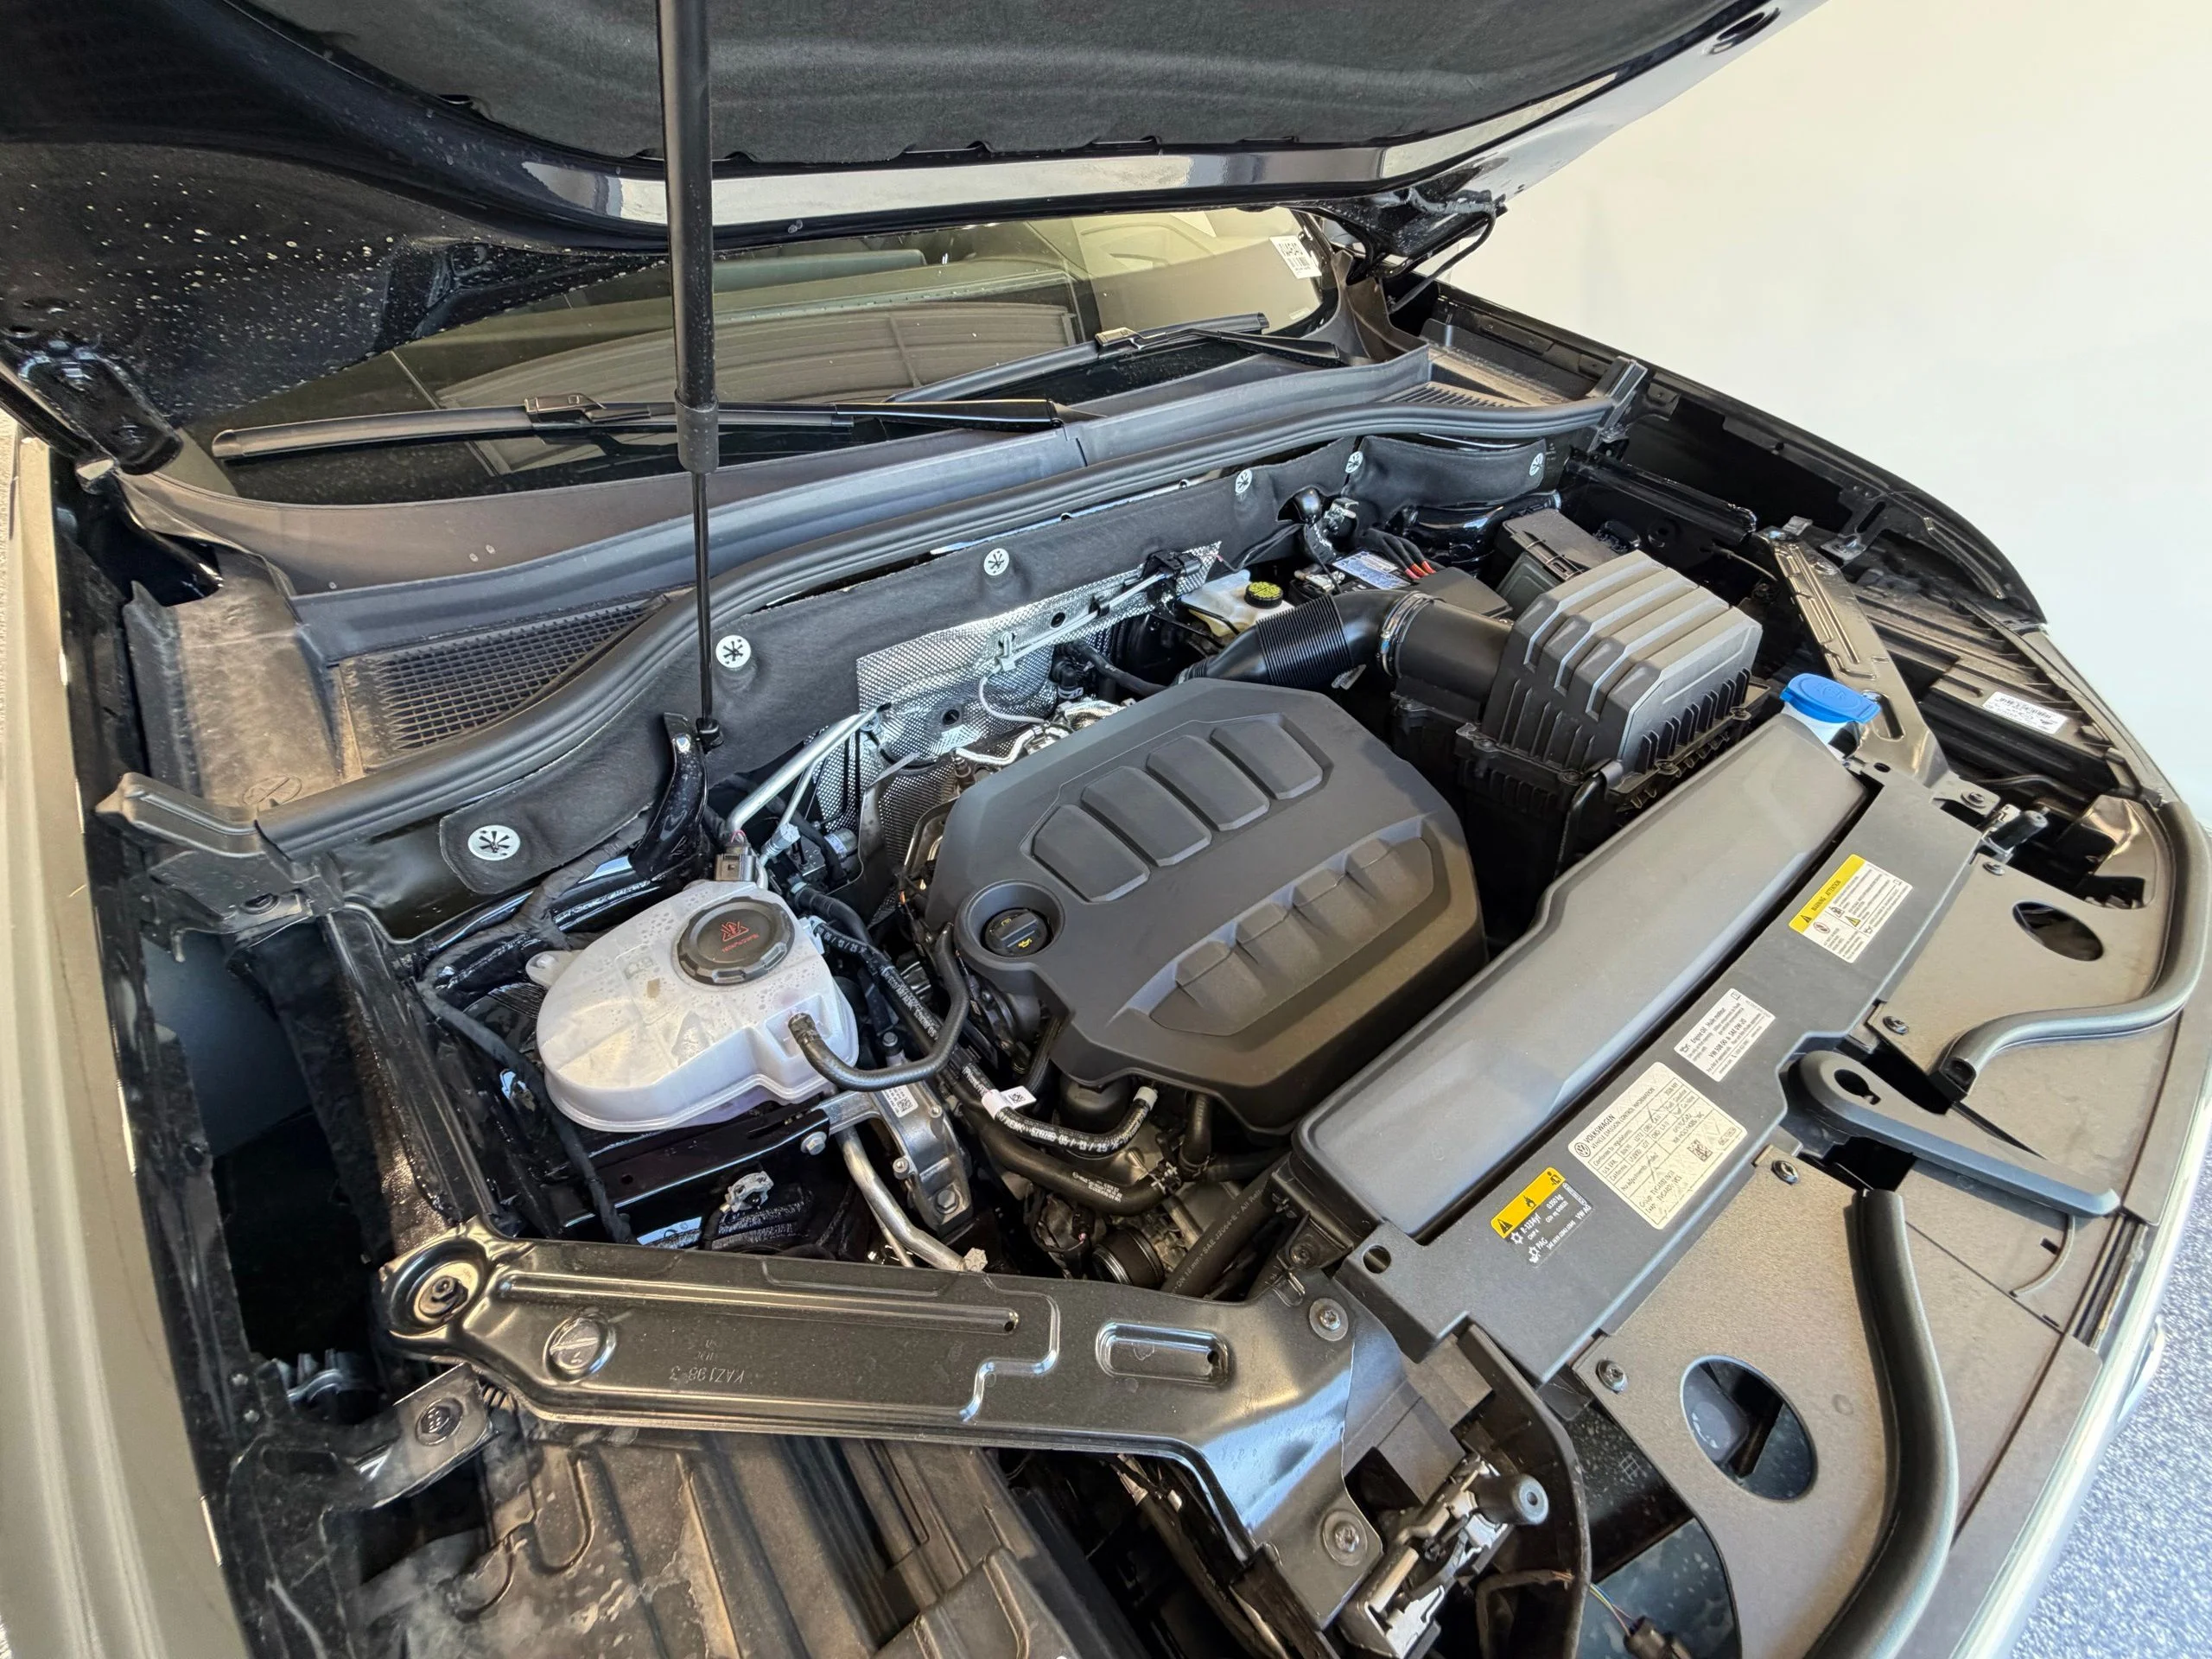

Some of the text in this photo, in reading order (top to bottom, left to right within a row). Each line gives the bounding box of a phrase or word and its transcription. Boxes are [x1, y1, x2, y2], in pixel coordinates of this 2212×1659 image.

[1707, 1049, 1718, 1058] VW
[1589, 1086, 1656, 1149] VEHICLE EMISSION CONTROL INFORMATION
[1582, 1113, 1616, 1145] VOLKSWAGEN
[1574, 1209, 1586, 1221] VW
[1581, 1203, 1592, 1213] AG
[1520, 1212, 1542, 1235] R-1234yf
[1535, 1236, 1548, 1249] PAG
